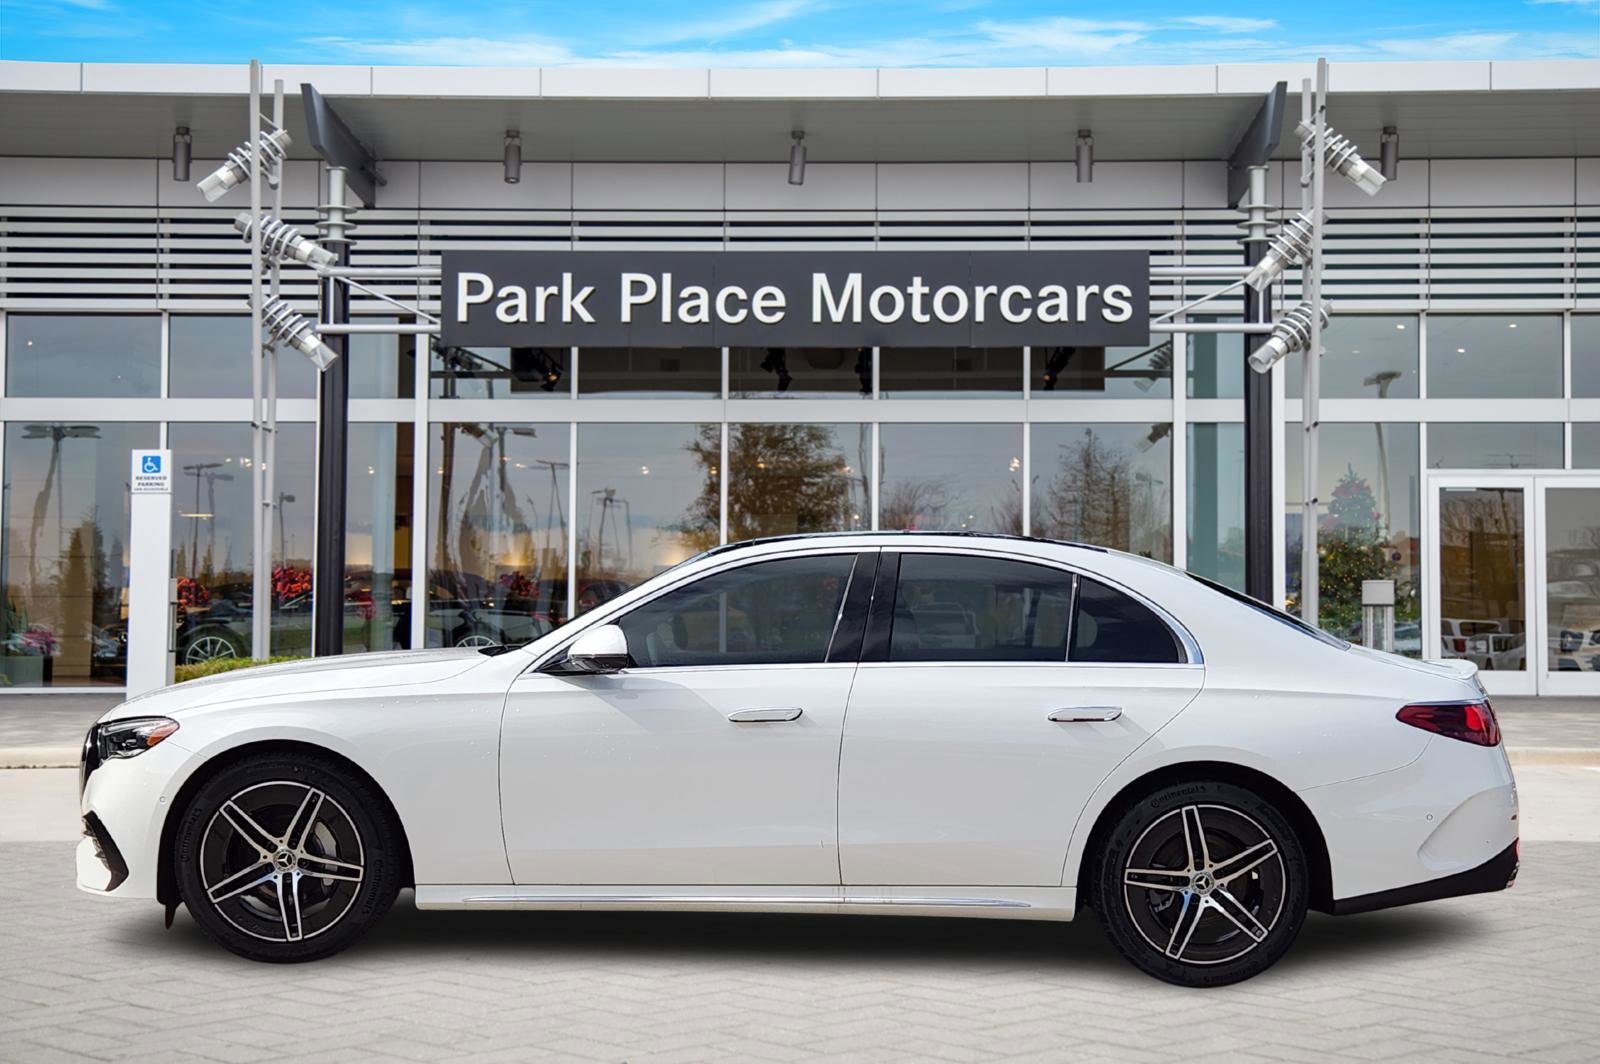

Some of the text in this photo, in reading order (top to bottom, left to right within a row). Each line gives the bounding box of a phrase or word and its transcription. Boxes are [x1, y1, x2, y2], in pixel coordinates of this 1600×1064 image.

[458, 273, 1133, 323] Park Place Motorcars
